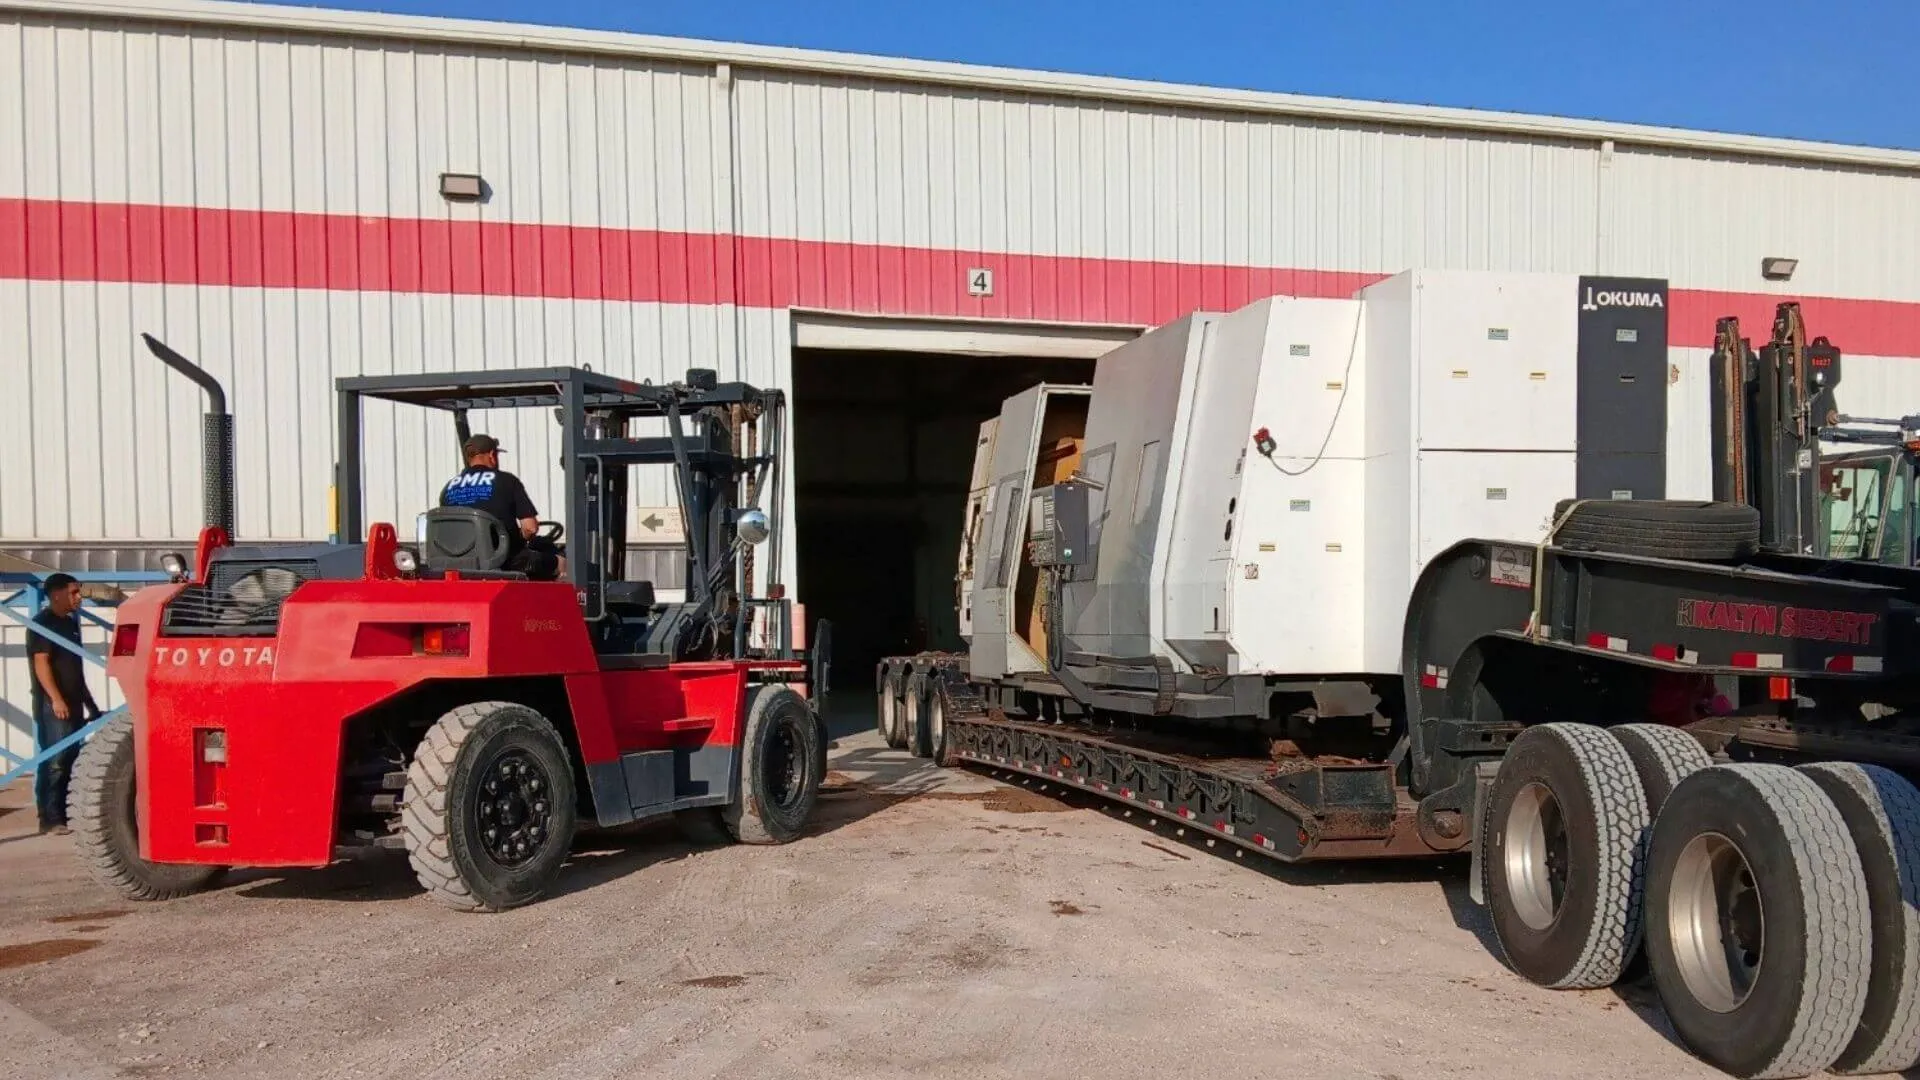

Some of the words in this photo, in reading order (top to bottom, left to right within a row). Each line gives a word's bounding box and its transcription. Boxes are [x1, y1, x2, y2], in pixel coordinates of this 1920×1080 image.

[973, 272, 987, 291] 4
[1597, 291, 1664, 307] OKUMA
[448, 471, 496, 490] PMR
[1694, 600, 1777, 635] KALYN
[1779, 606, 1880, 645] SIEBERT
[155, 646, 273, 666] TOYOTA
